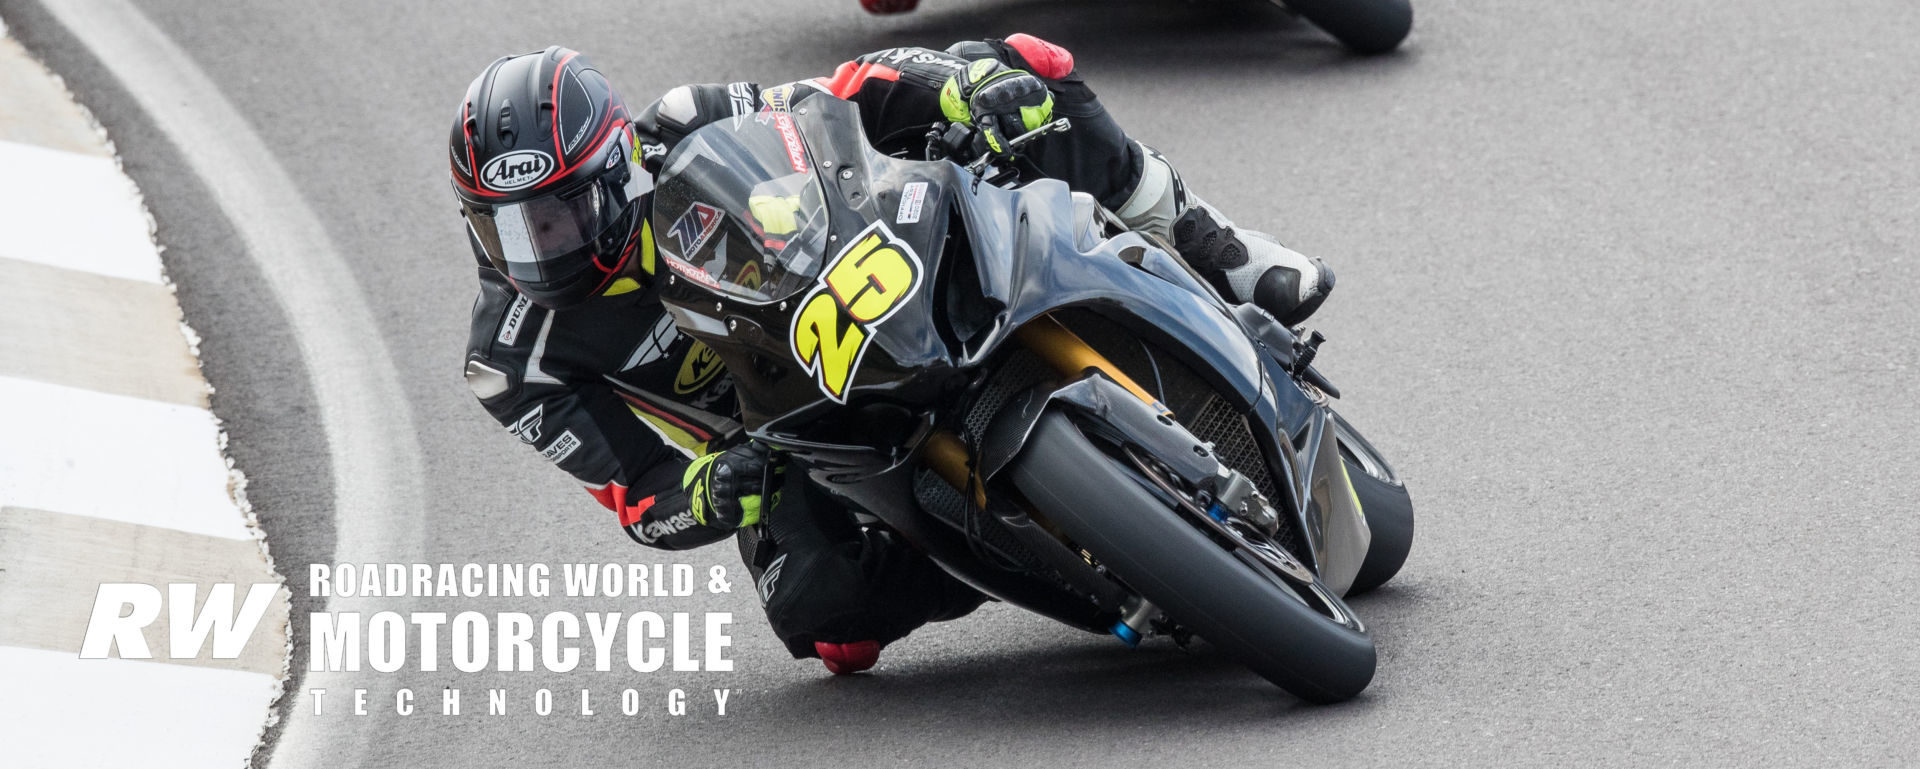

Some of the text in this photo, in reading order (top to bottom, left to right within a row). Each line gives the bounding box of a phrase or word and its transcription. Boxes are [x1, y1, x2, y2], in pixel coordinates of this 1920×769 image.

[488, 154, 542, 183] Arai
[504, 176, 531, 185] HELMET
[508, 295, 529, 329] DUNL
[793, 228, 917, 400] 25
[630, 508, 698, 544] Kawas
